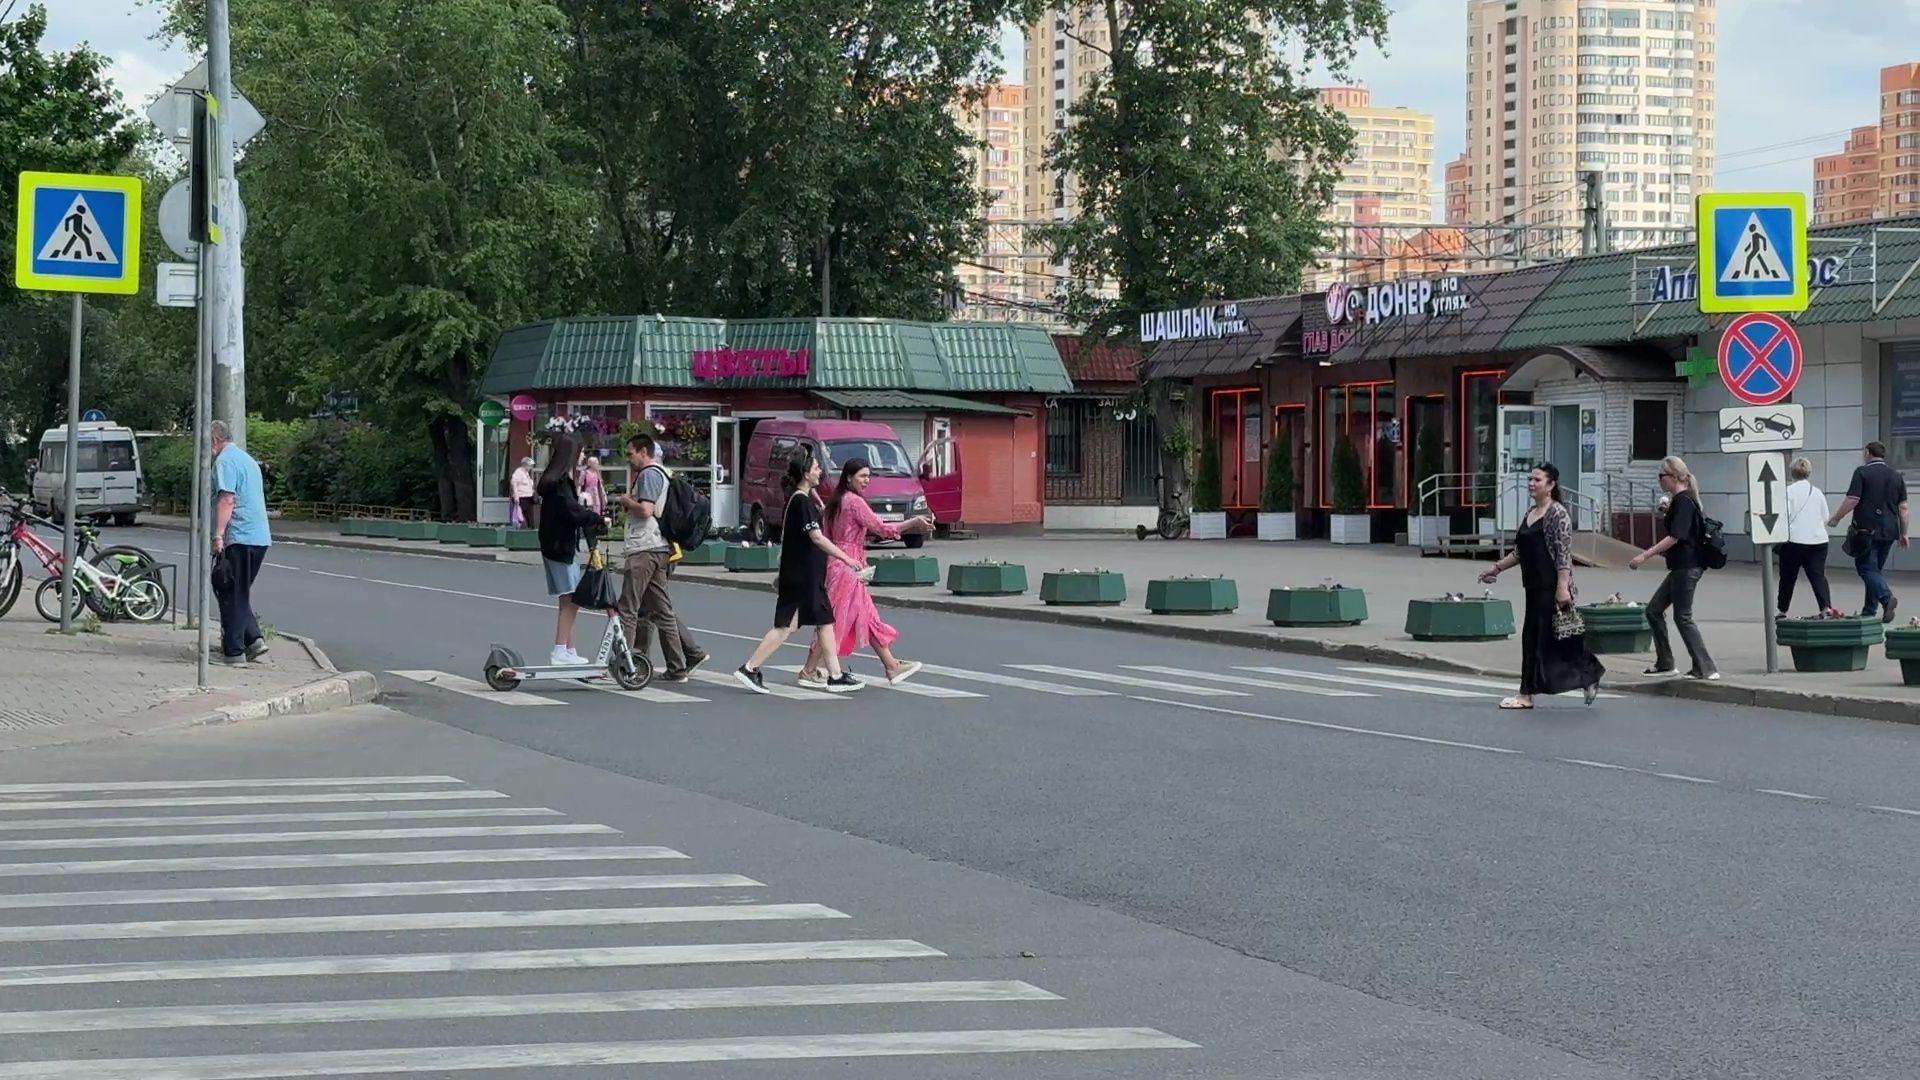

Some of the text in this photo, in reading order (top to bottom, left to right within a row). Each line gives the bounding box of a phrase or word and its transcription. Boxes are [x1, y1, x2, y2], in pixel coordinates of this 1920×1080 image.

[1441, 277, 1458, 292] на
[1224, 303, 1238, 318] на
[1366, 281, 1432, 325] ДОНЕР
[1432, 294, 1467, 318] углях
[1140, 306, 1217, 342] ШАШЛЫК
[693, 348, 810, 380] ЦВЕТЫ
